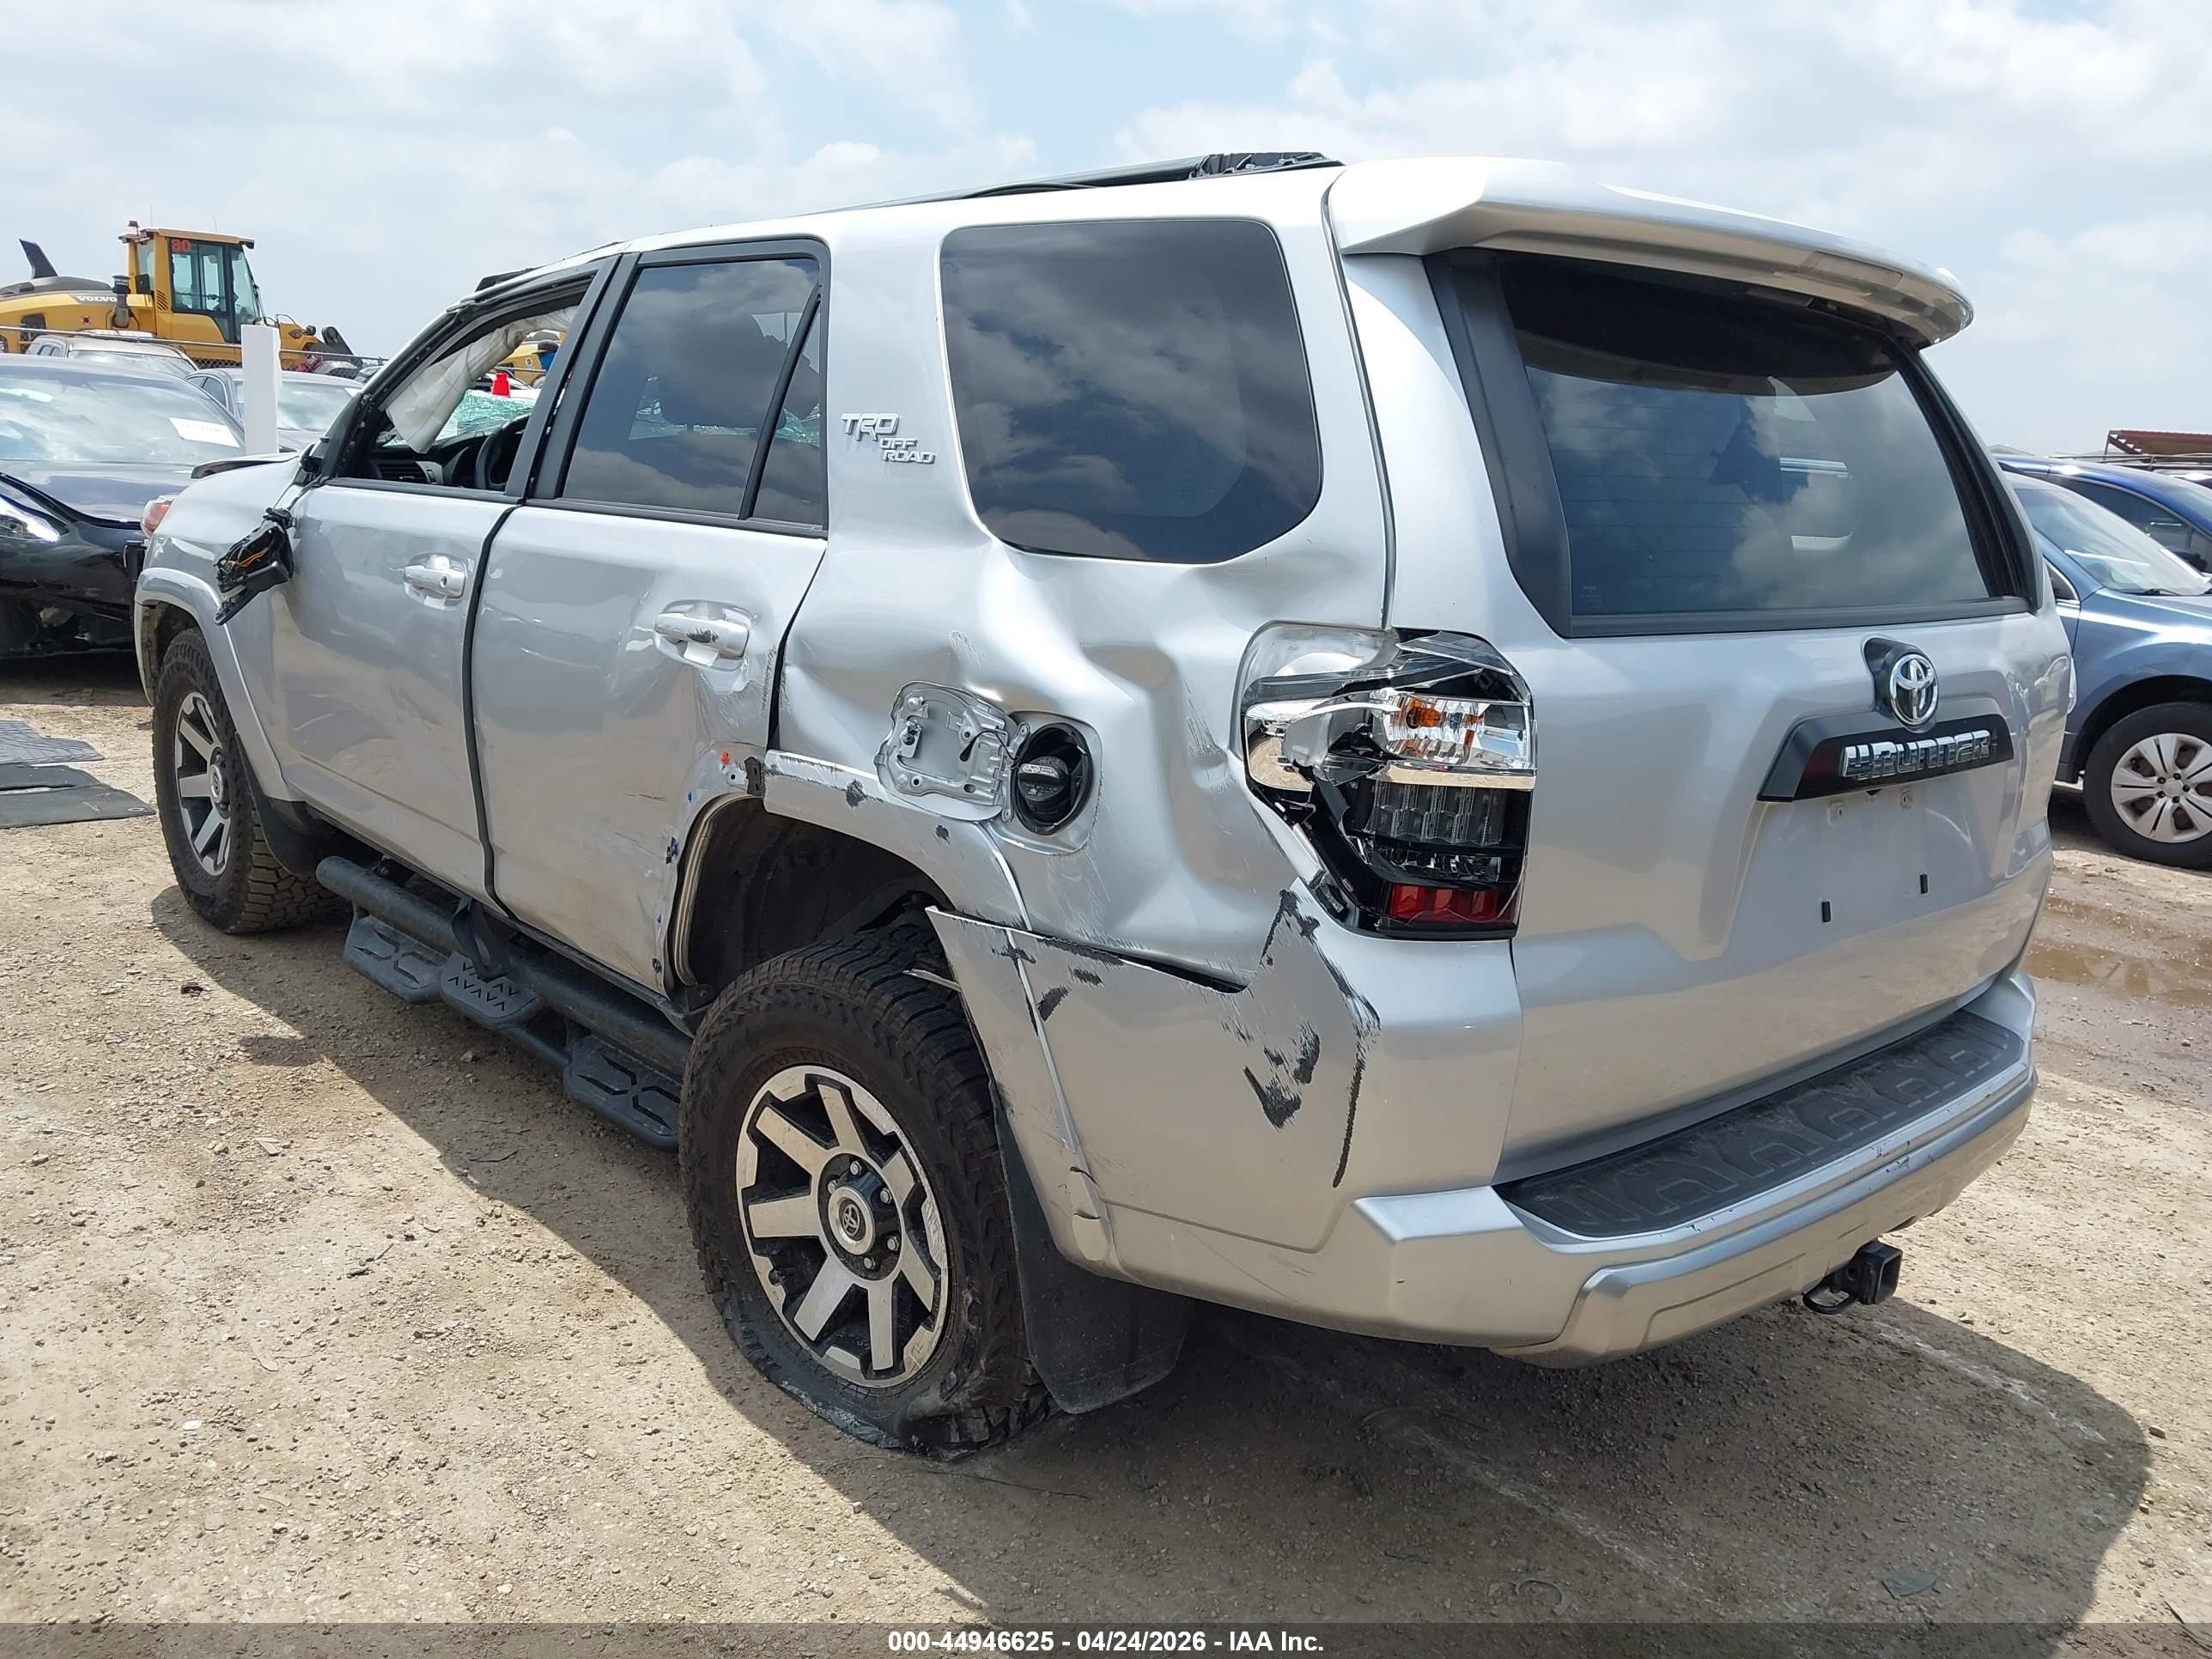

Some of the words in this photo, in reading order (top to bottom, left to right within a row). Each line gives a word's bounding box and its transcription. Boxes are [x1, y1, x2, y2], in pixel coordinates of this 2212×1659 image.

[841, 412, 899, 441] TRD
[879, 438, 918, 450] OFF
[883, 450, 935, 464] ROAD
